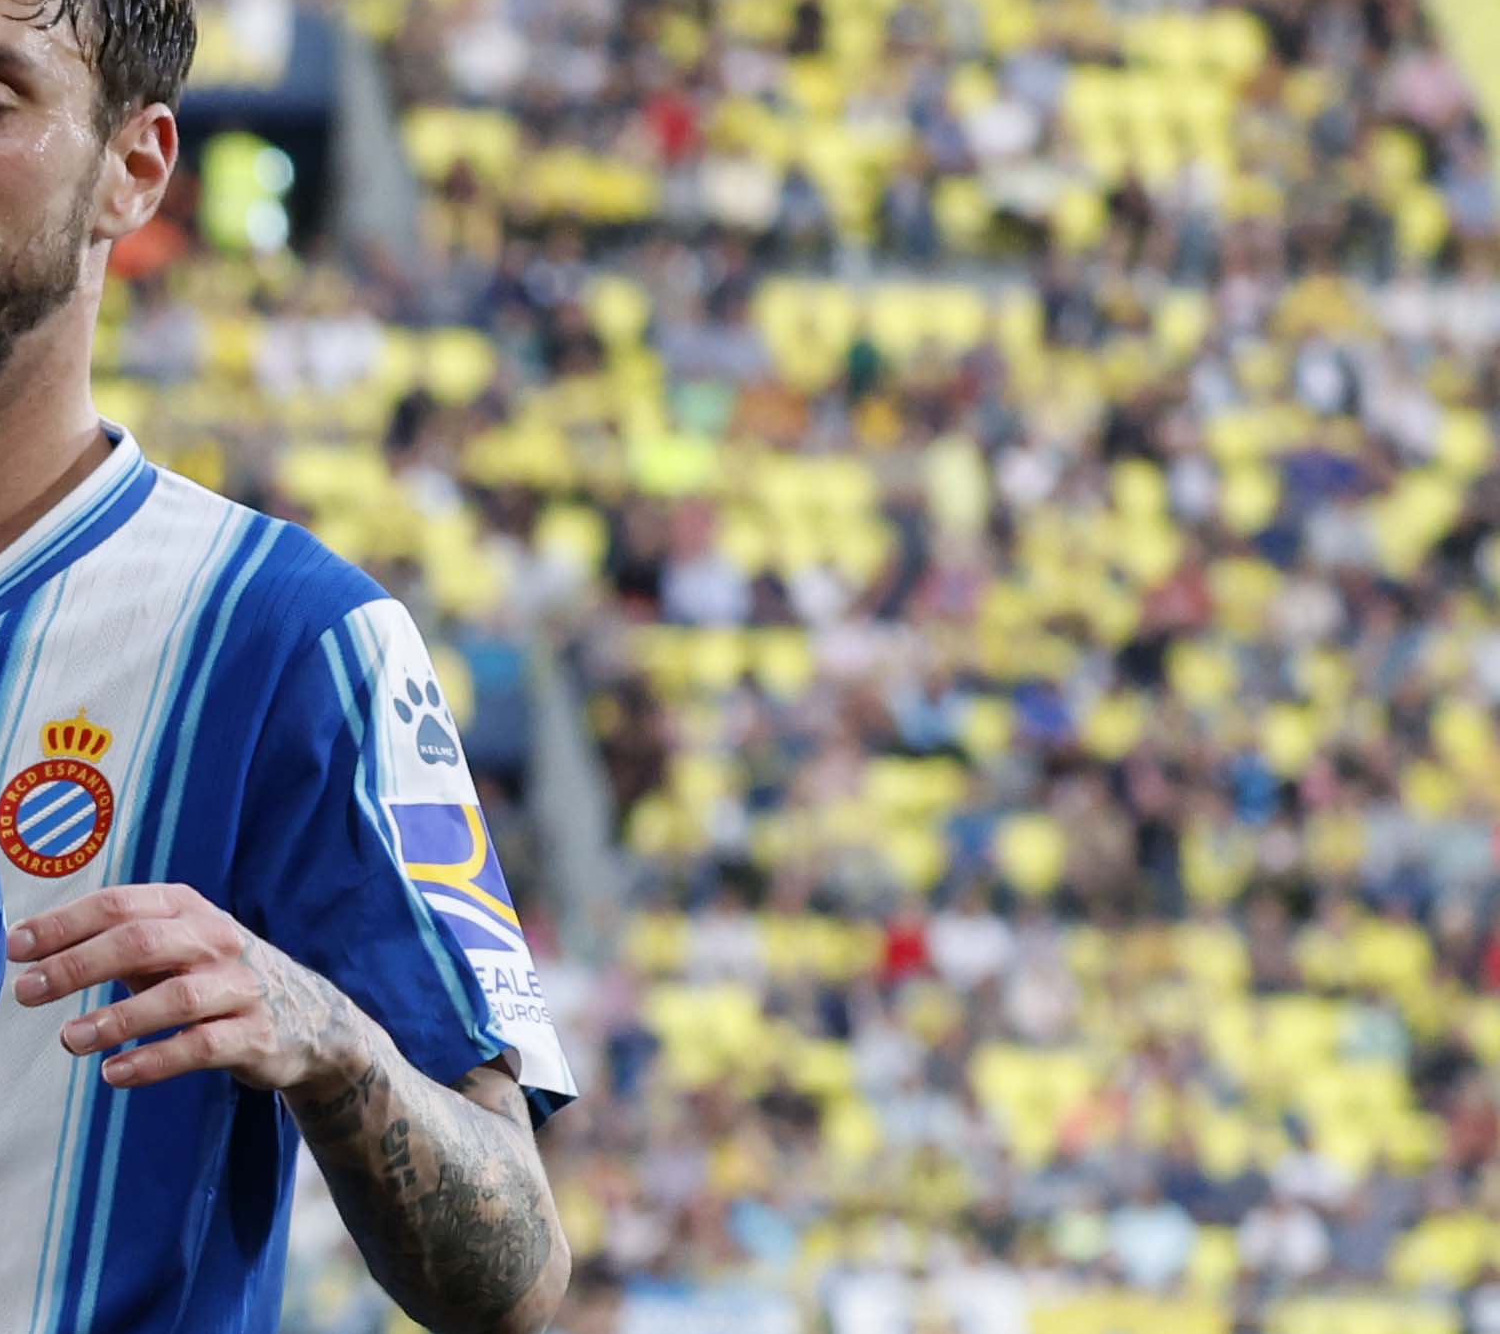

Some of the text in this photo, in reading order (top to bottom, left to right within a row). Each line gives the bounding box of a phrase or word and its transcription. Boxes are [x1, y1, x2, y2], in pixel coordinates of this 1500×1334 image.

[6, 762, 113, 817] RCD ESPANYOL
[0, 816, 105, 873] DE BARCELONA
